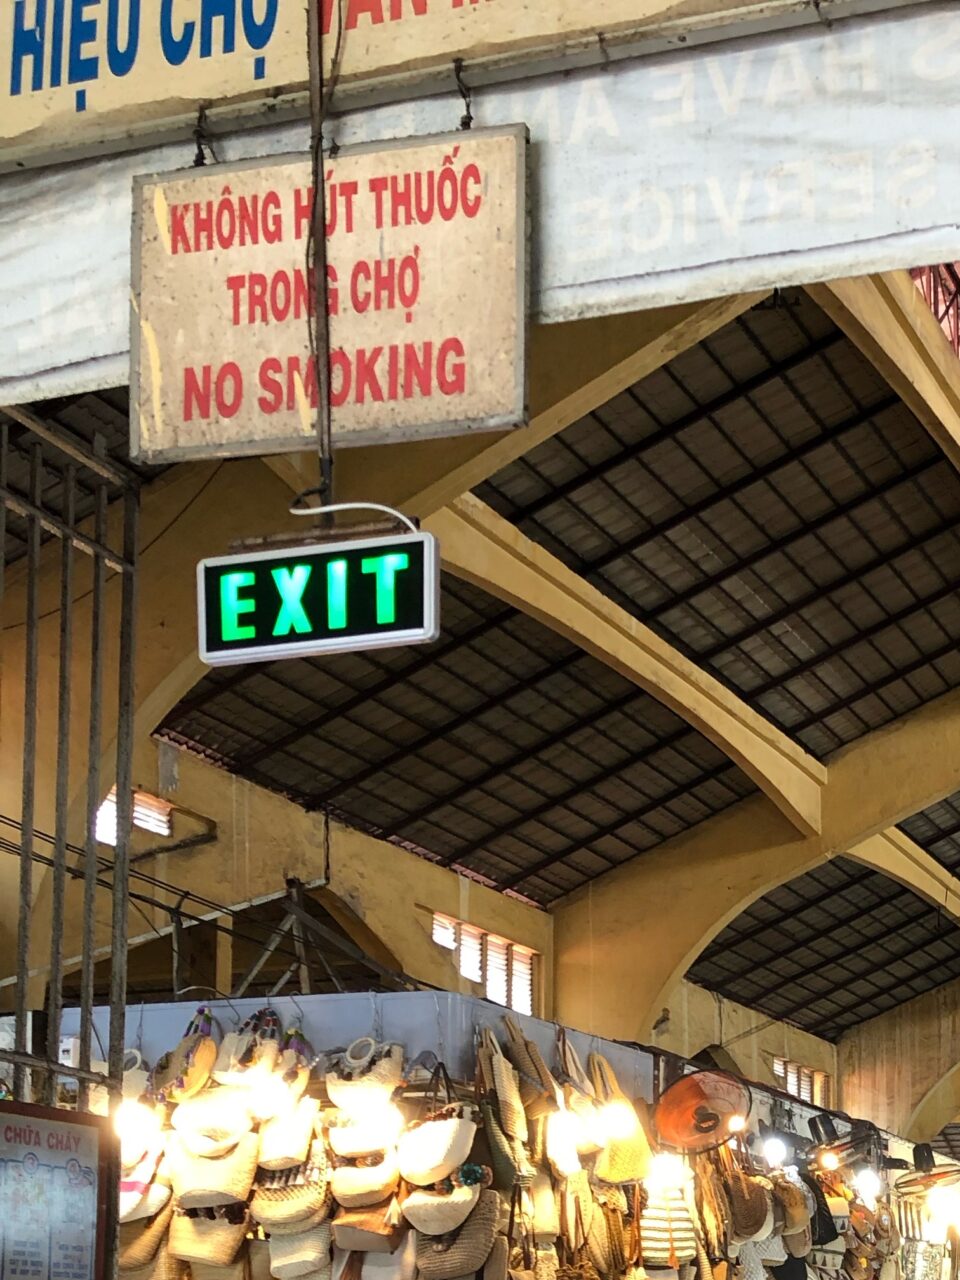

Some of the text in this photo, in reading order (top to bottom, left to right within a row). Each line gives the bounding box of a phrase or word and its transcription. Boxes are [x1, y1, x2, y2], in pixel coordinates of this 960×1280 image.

[171, 185, 282, 254] KHÔNG
[369, 146, 482, 230] THUỐC
[350, 244, 421, 323] CHỢ
[183, 337, 465, 421] NO SMOKING
[219, 553, 409, 641] EXIT
